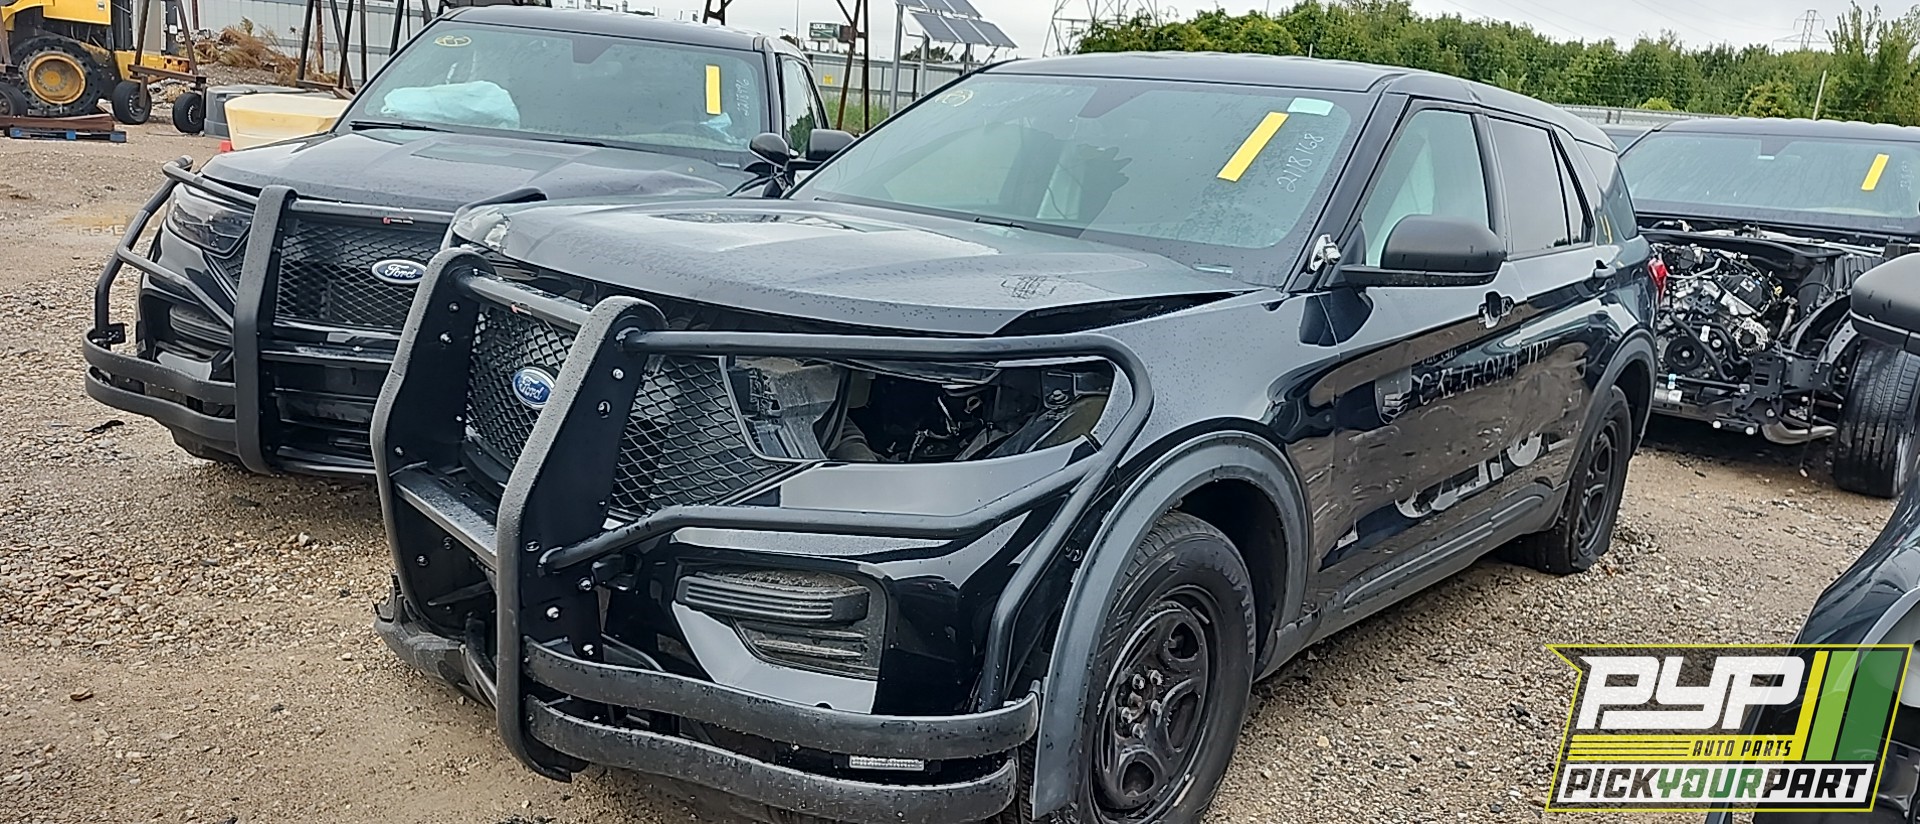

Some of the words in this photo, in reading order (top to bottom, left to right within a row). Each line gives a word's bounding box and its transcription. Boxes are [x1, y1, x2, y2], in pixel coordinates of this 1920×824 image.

[1276, 133, 1325, 193] 2118168
[384, 263, 417, 278] Ford
[518, 375, 545, 400] Ford
